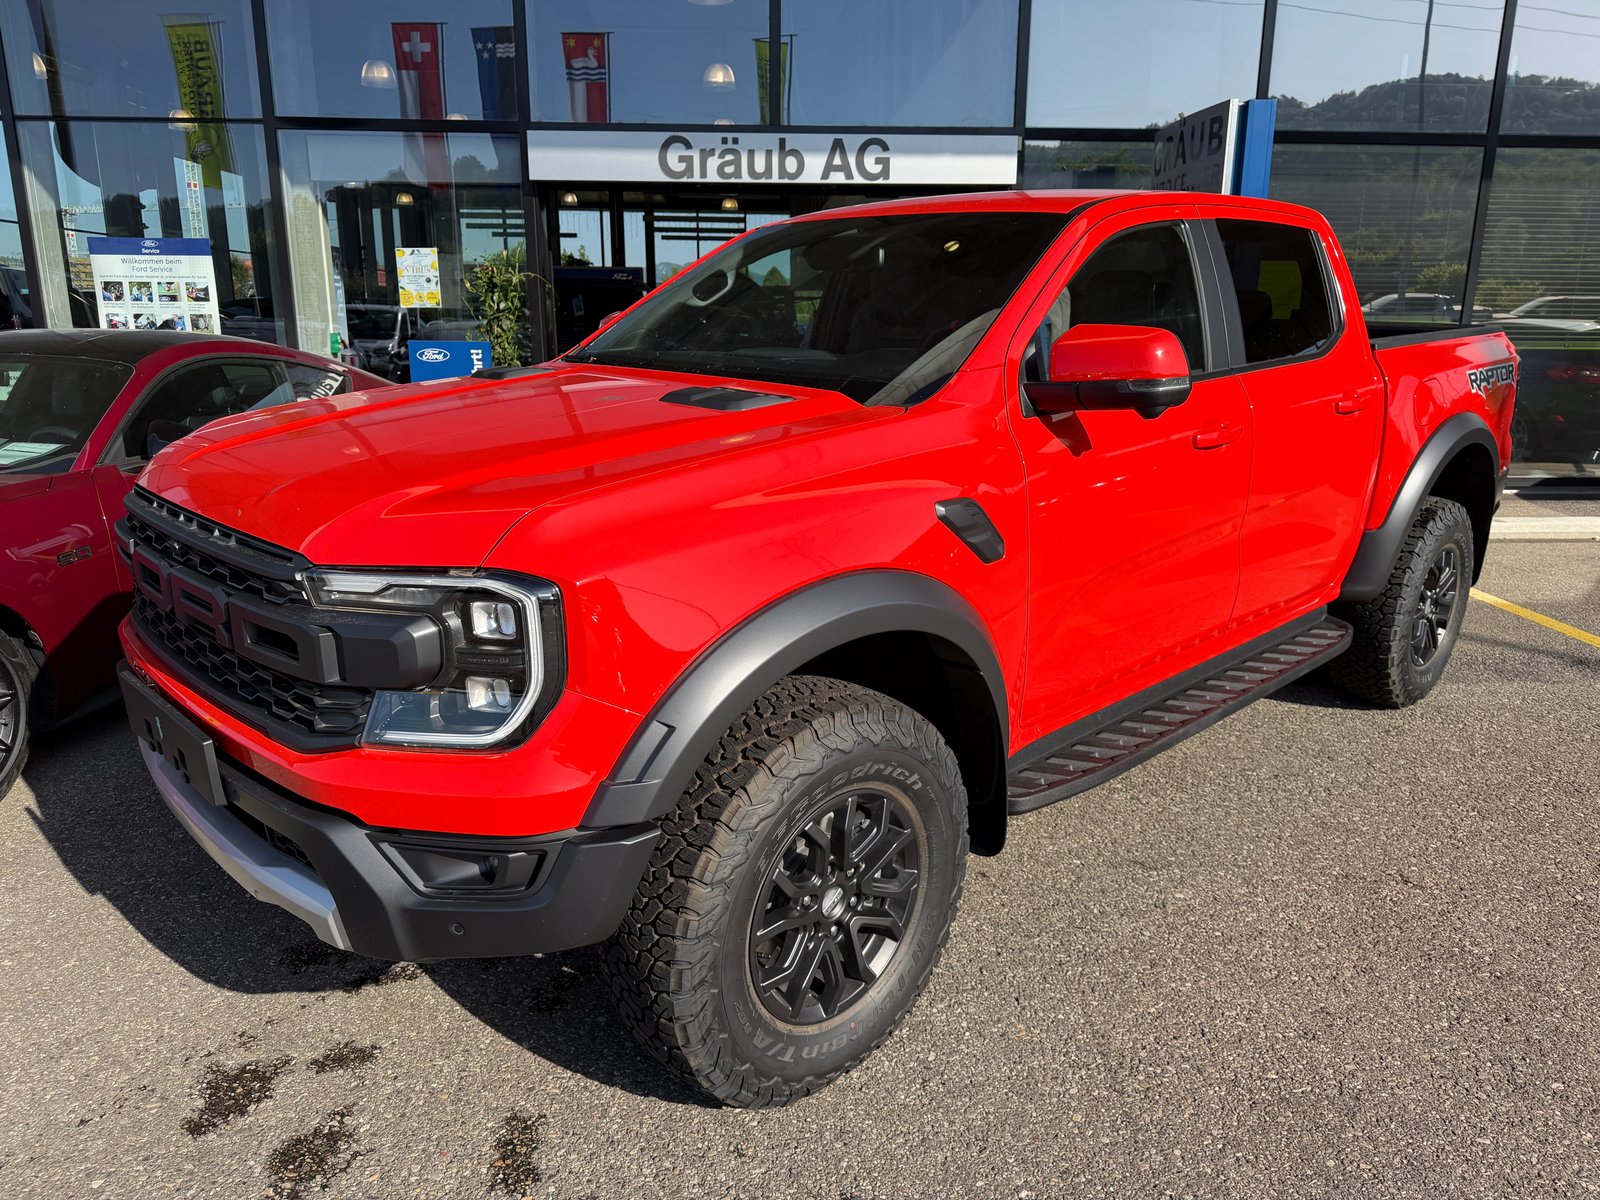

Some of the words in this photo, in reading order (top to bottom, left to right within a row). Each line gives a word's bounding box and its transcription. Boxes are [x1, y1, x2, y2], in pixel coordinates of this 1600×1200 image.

[658, 134, 805, 181] Gräub
[820, 137, 890, 181] AG
[120, 257, 164, 265] Willkommen
[165, 257, 182, 265] beim
[132, 265, 148, 273] Ford
[149, 265, 173, 273] Service
[1467, 362, 1515, 399] RAPTOR
